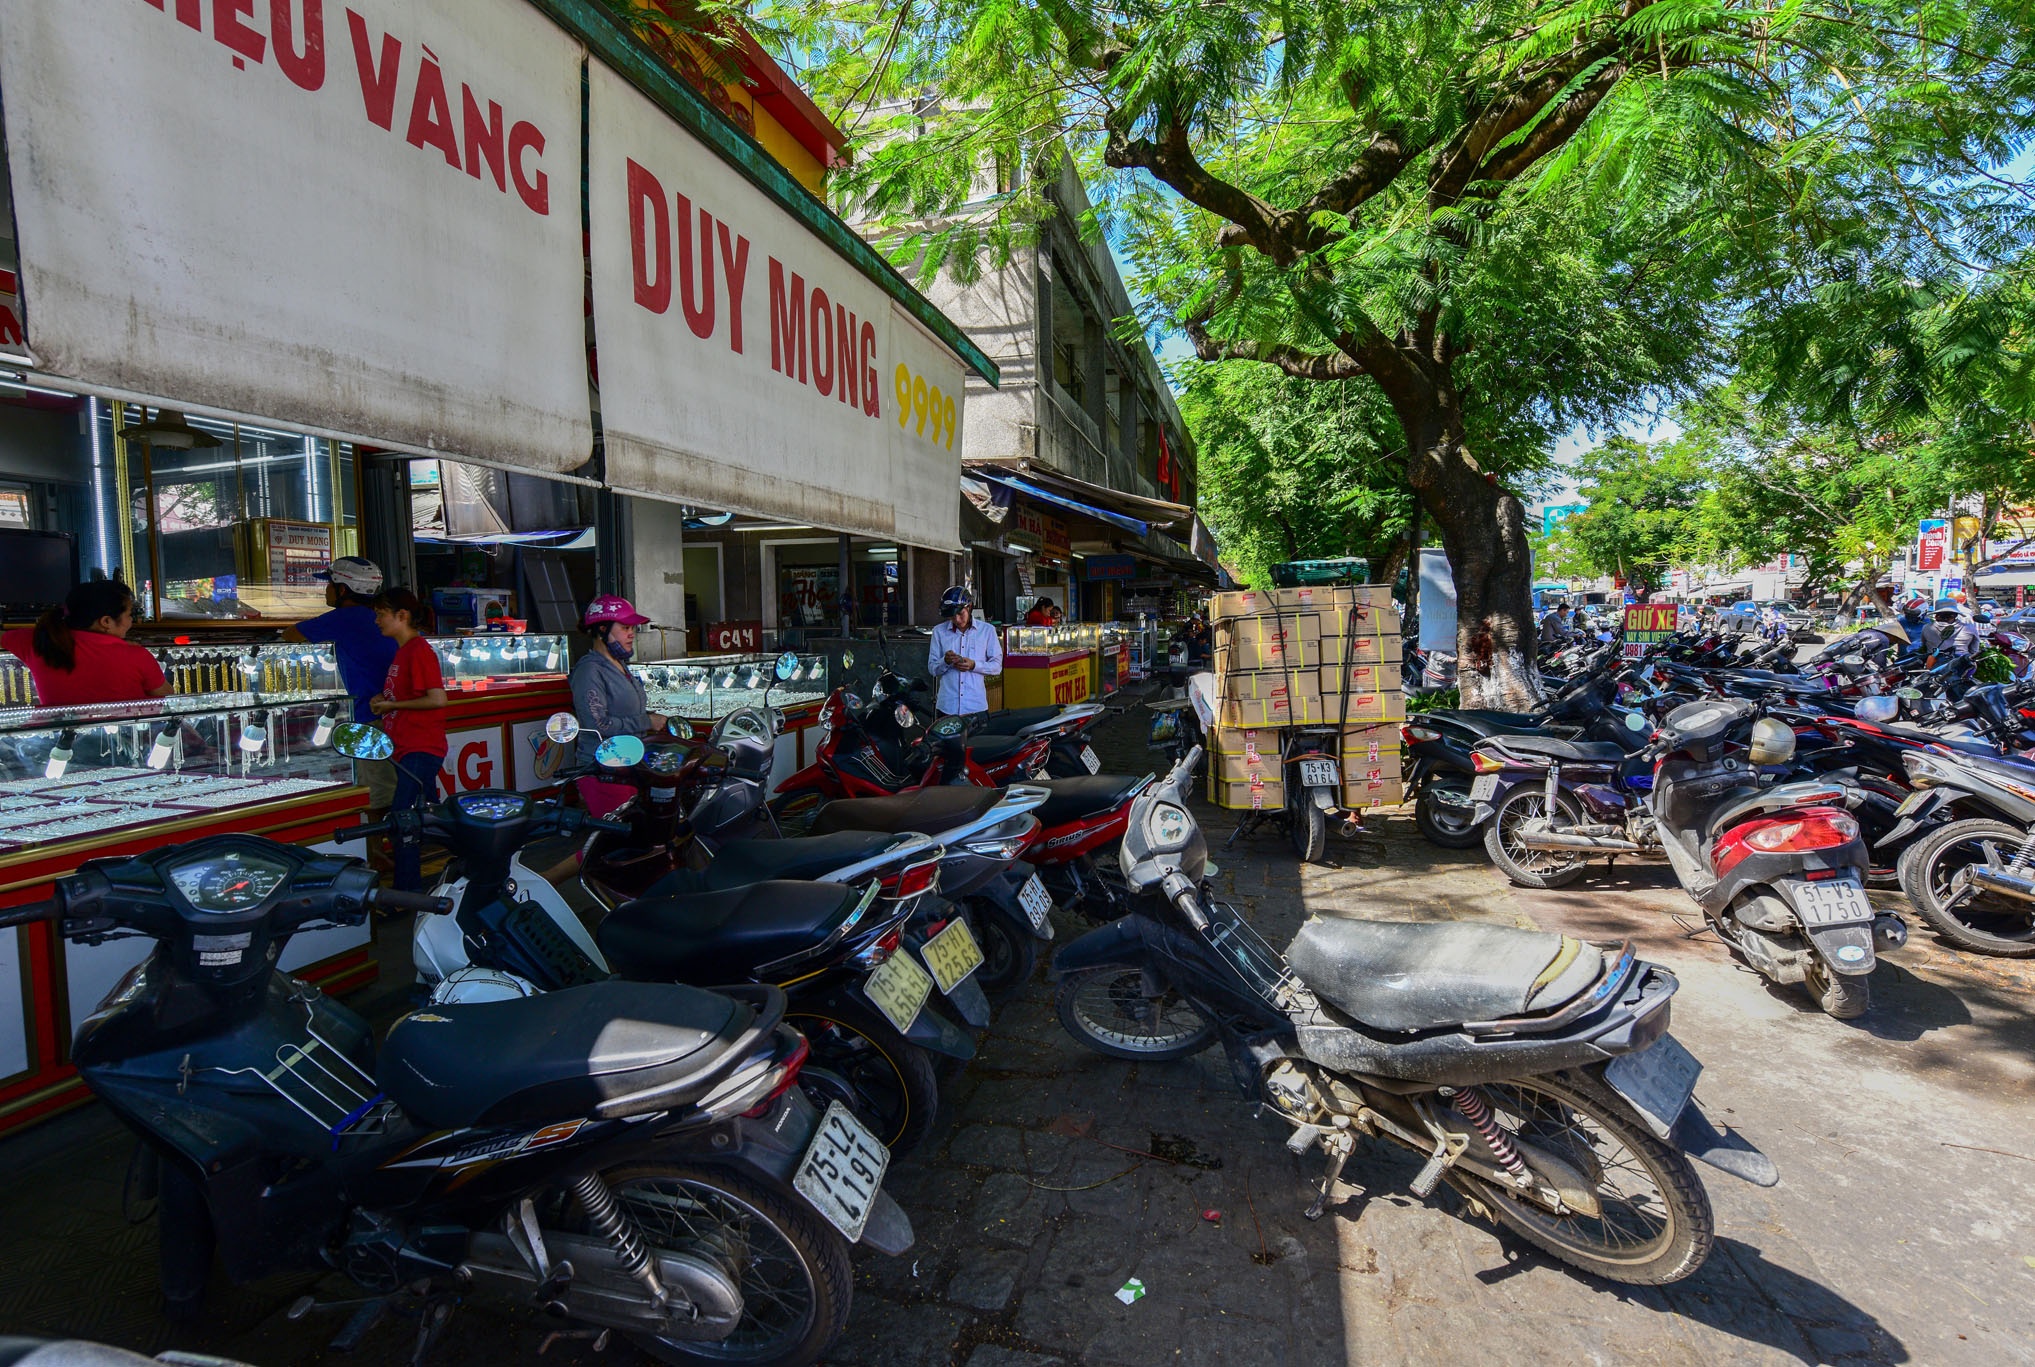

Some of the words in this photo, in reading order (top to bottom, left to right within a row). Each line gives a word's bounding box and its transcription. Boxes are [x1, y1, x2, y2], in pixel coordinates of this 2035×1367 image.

[344, 7, 550, 216] VÀNG
[626, 157, 750, 355] DUY
[768, 255, 880, 419] MONG
[894, 362, 957, 452] 9999
[288, 535, 305, 545] DUY
[307, 536, 329, 546] MONG
[1627, 605, 1655, 631] GIỮ
[1656, 609, 1676, 630] XE
[1625, 644, 1642, 657] 0981
[1054, 680, 1073, 705] KIM
[1305, 762, 1331, 773] 75-K3
[1307, 774, 1333, 784] 8164
[1803, 881, 1855, 903] 51-V3
[1810, 900, 1862, 922] 1750
[929, 925, 966, 963] 75-H1
[938, 942, 980, 988] 125.63
[889, 968, 929, 1026] 456.54
[804, 1115, 857, 1194] 75-L2
[834, 1143, 881, 1221] 4191
